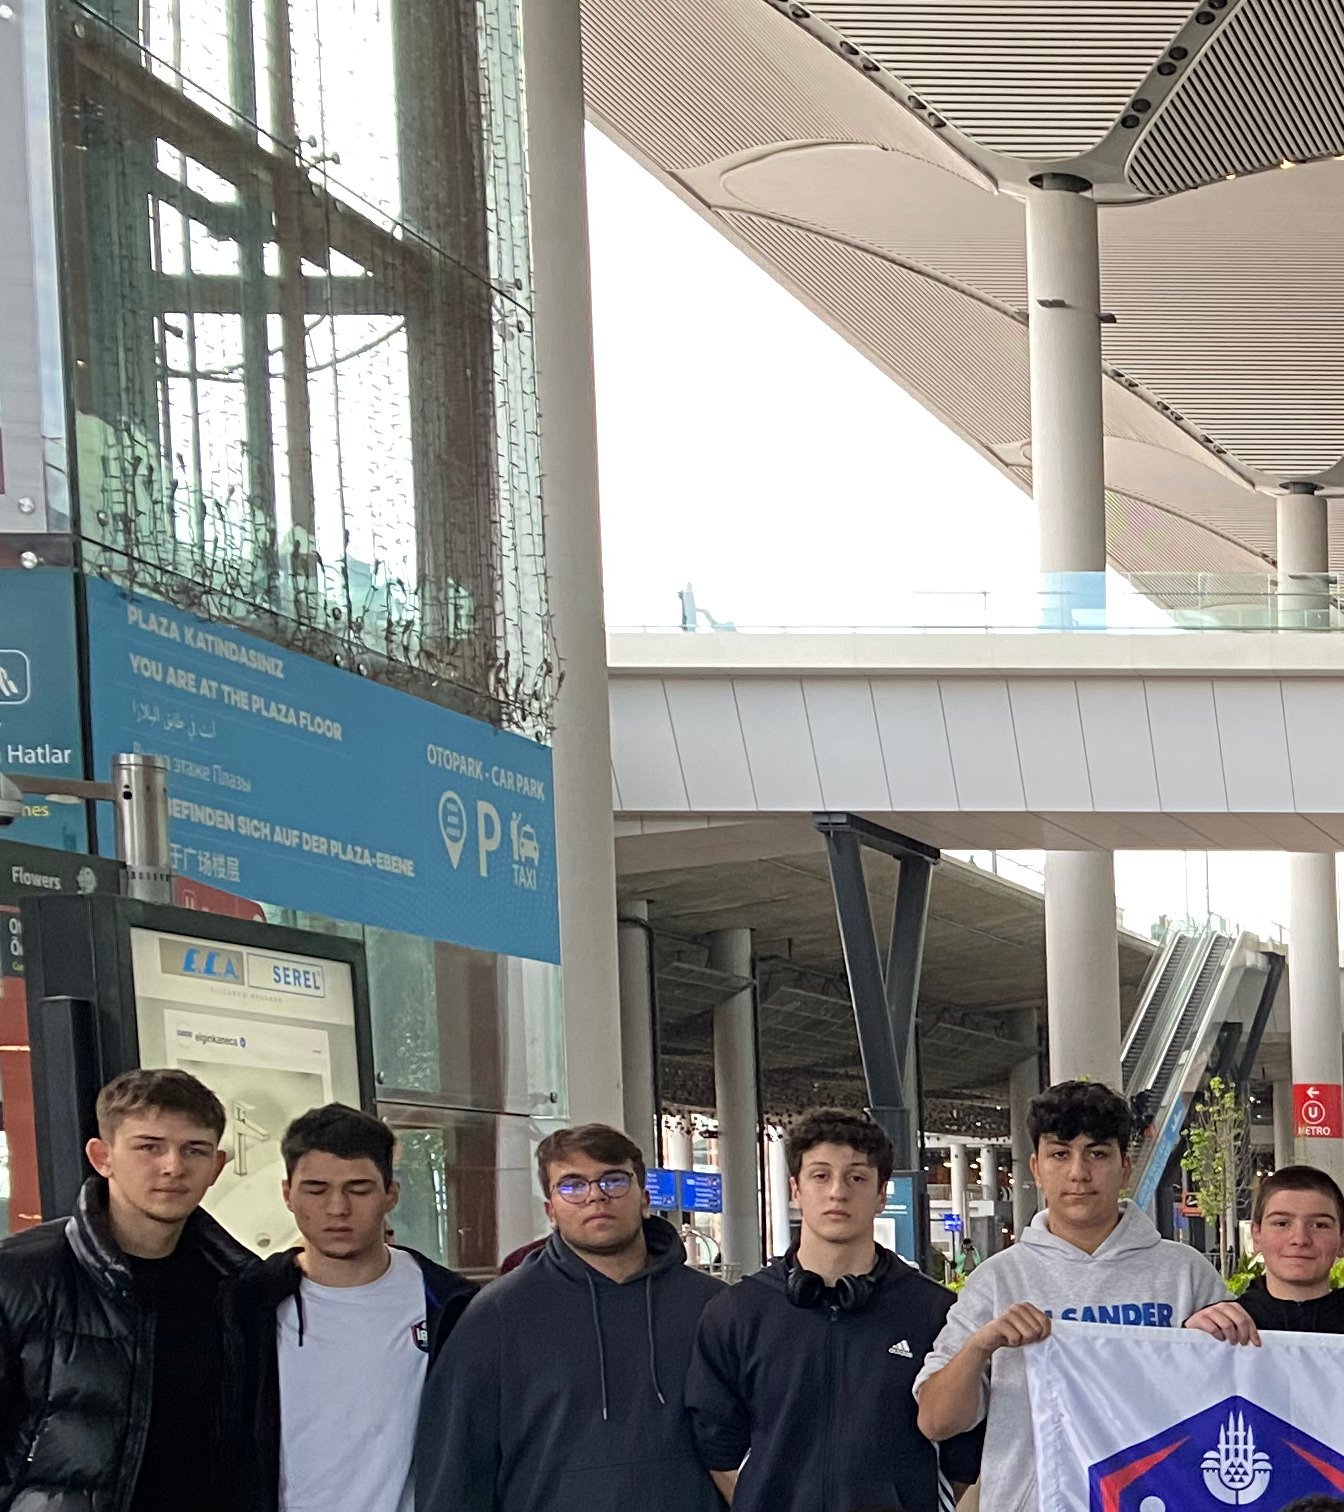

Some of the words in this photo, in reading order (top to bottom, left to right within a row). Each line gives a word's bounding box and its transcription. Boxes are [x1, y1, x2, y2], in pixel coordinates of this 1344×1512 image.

[127, 604, 181, 642] PLAZA
[184, 624, 285, 679] KATINDASINIZ
[129, 652, 163, 682] YOU
[166, 666, 197, 694] ARE
[199, 677, 219, 700] AT
[221, 684, 249, 710] THE
[252, 696, 298, 727] PLAZA
[300, 710, 343, 742] FLOOR
[7, 744, 72, 764] Hatlar
[426, 744, 483, 781] OTOPARK
[491, 766, 515, 791] CAR
[516, 773, 545, 801] PARK
[21, 804, 50, 817] nes
[237, 815, 271, 841] SICH
[274, 825, 301, 848] AUF
[302, 831, 328, 854] DER
[330, 840, 415, 878] PLAZA-EBENE
[477, 800, 502, 877] P
[11, 866, 62, 890] Flowers
[512, 864, 537, 890] TAXI
[273, 965, 321, 990] SEREL
